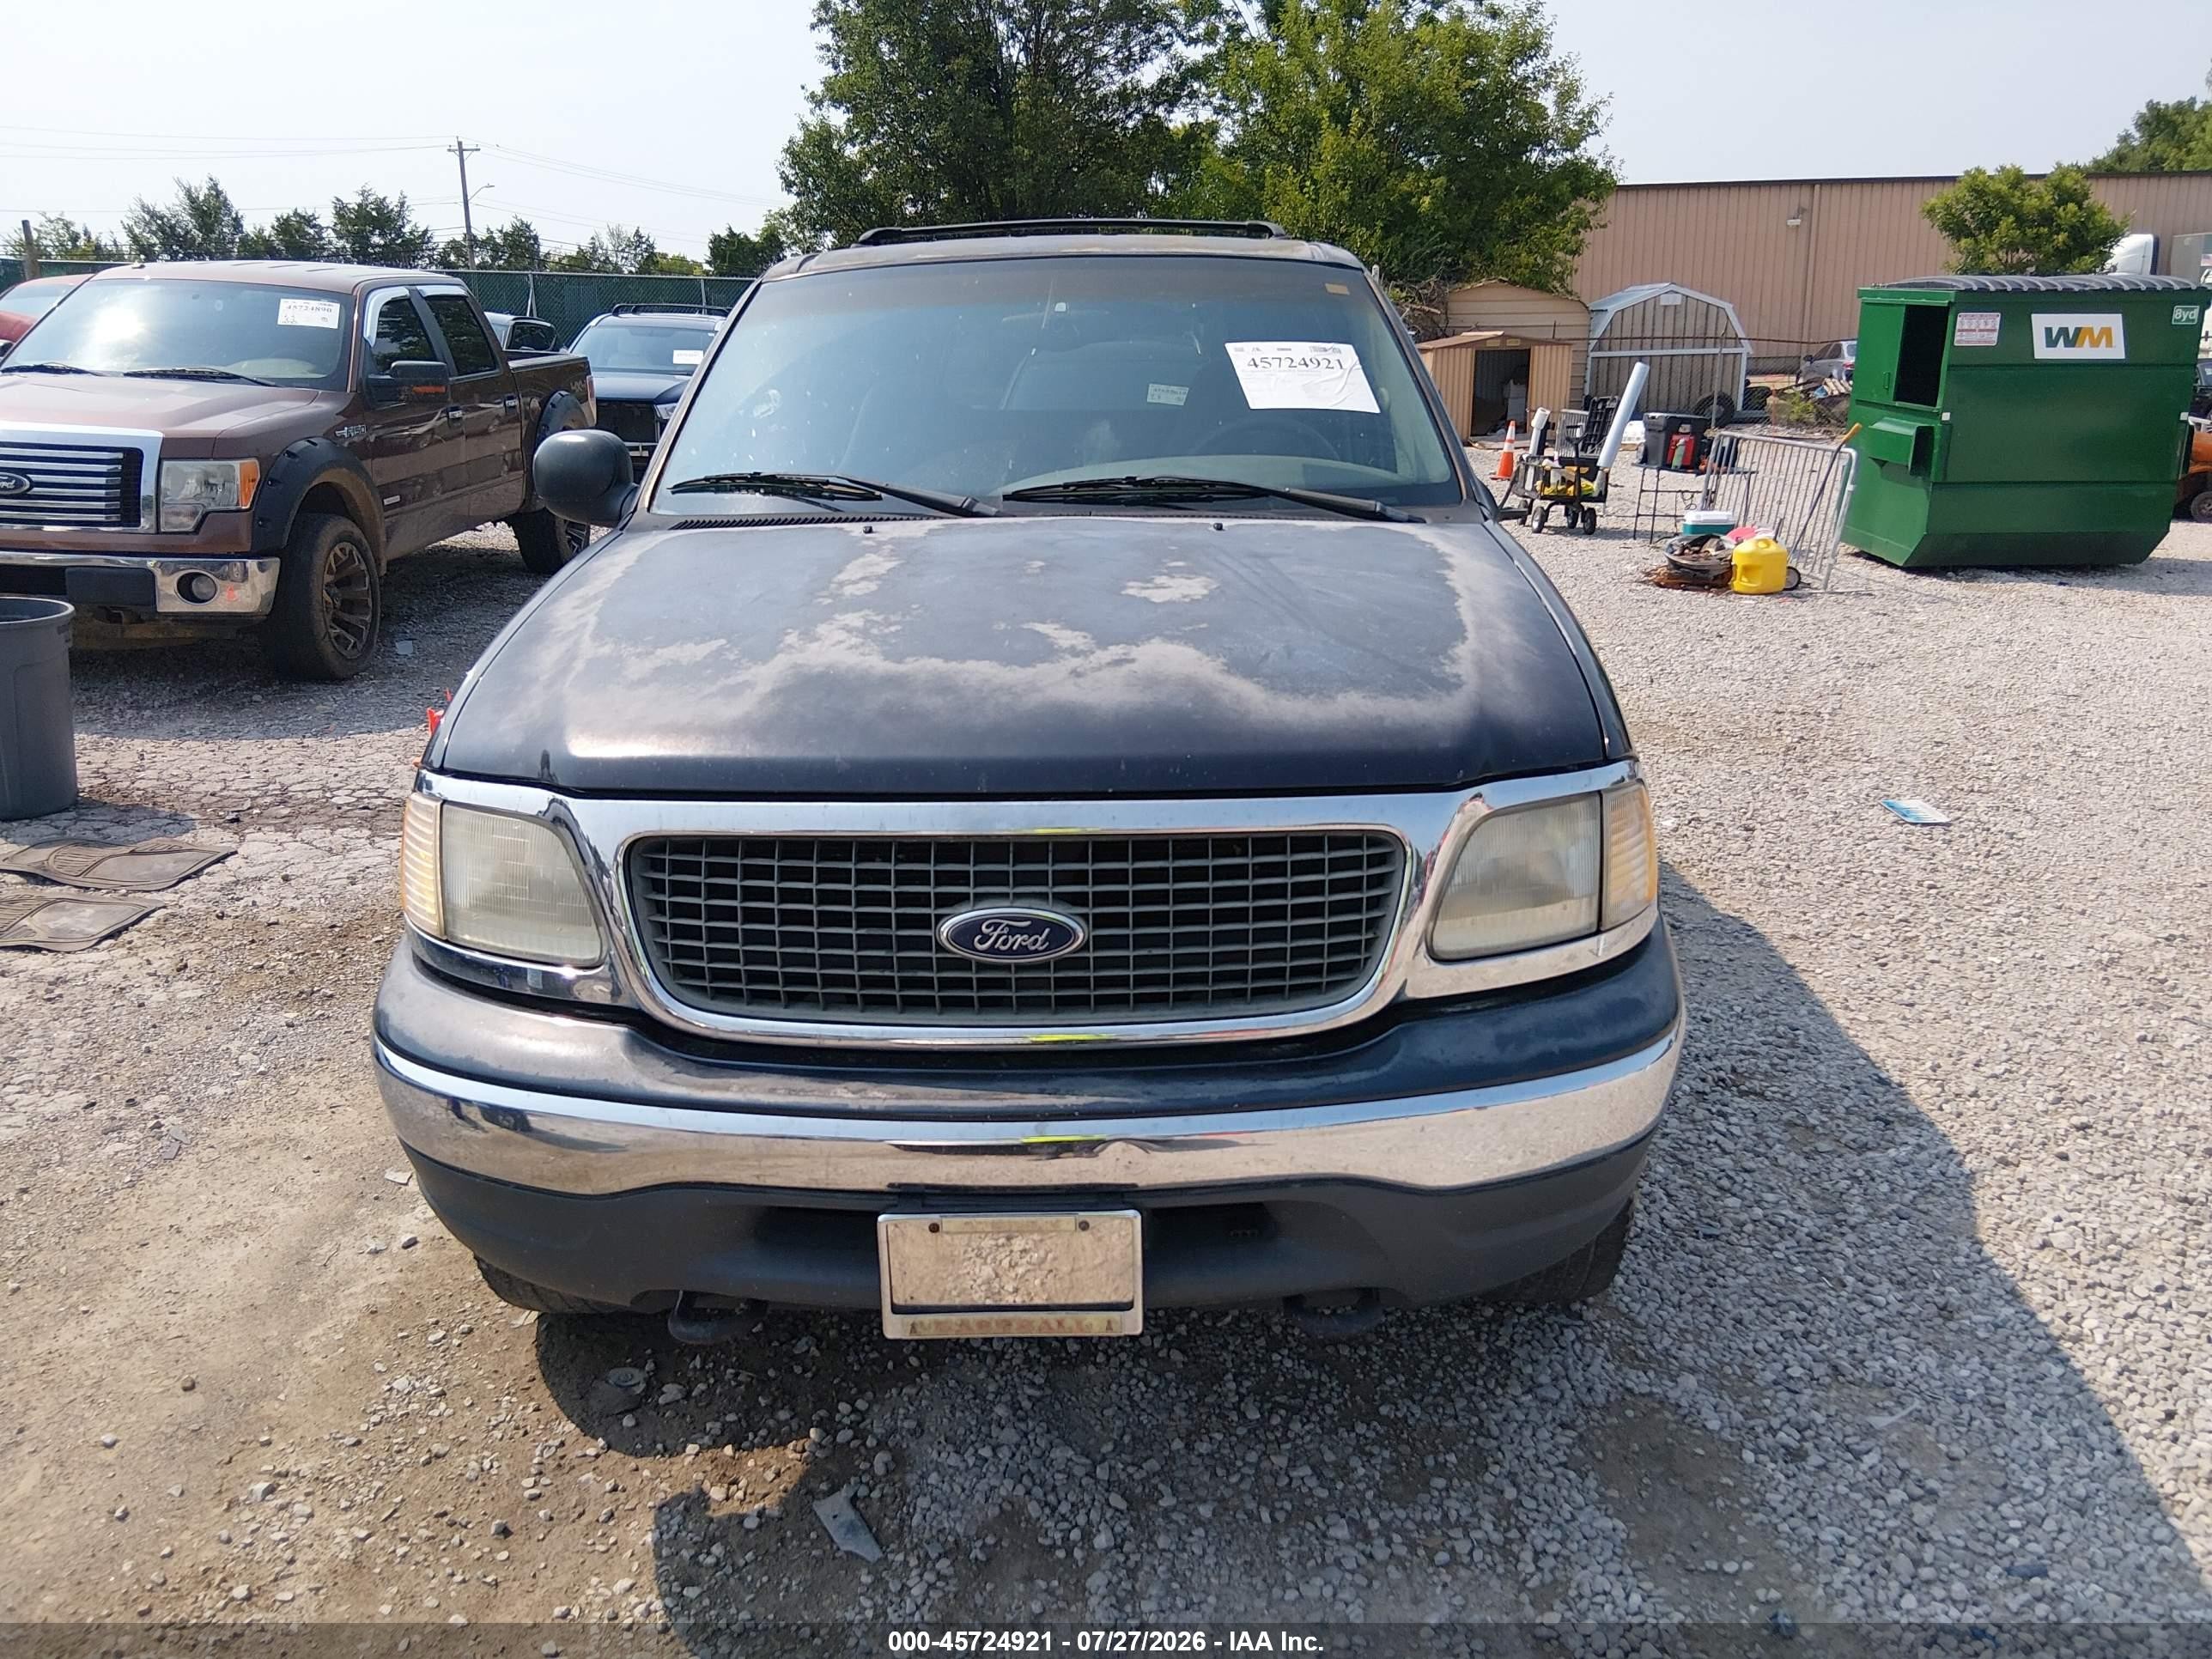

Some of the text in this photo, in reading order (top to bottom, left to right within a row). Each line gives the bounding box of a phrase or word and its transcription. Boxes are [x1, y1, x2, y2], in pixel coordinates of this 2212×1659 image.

[2173, 307, 2197, 322] 8yd
[2044, 325, 2114, 349] WM
[1247, 356, 1345, 370] 45724921
[973, 918, 1051, 951] Ford
